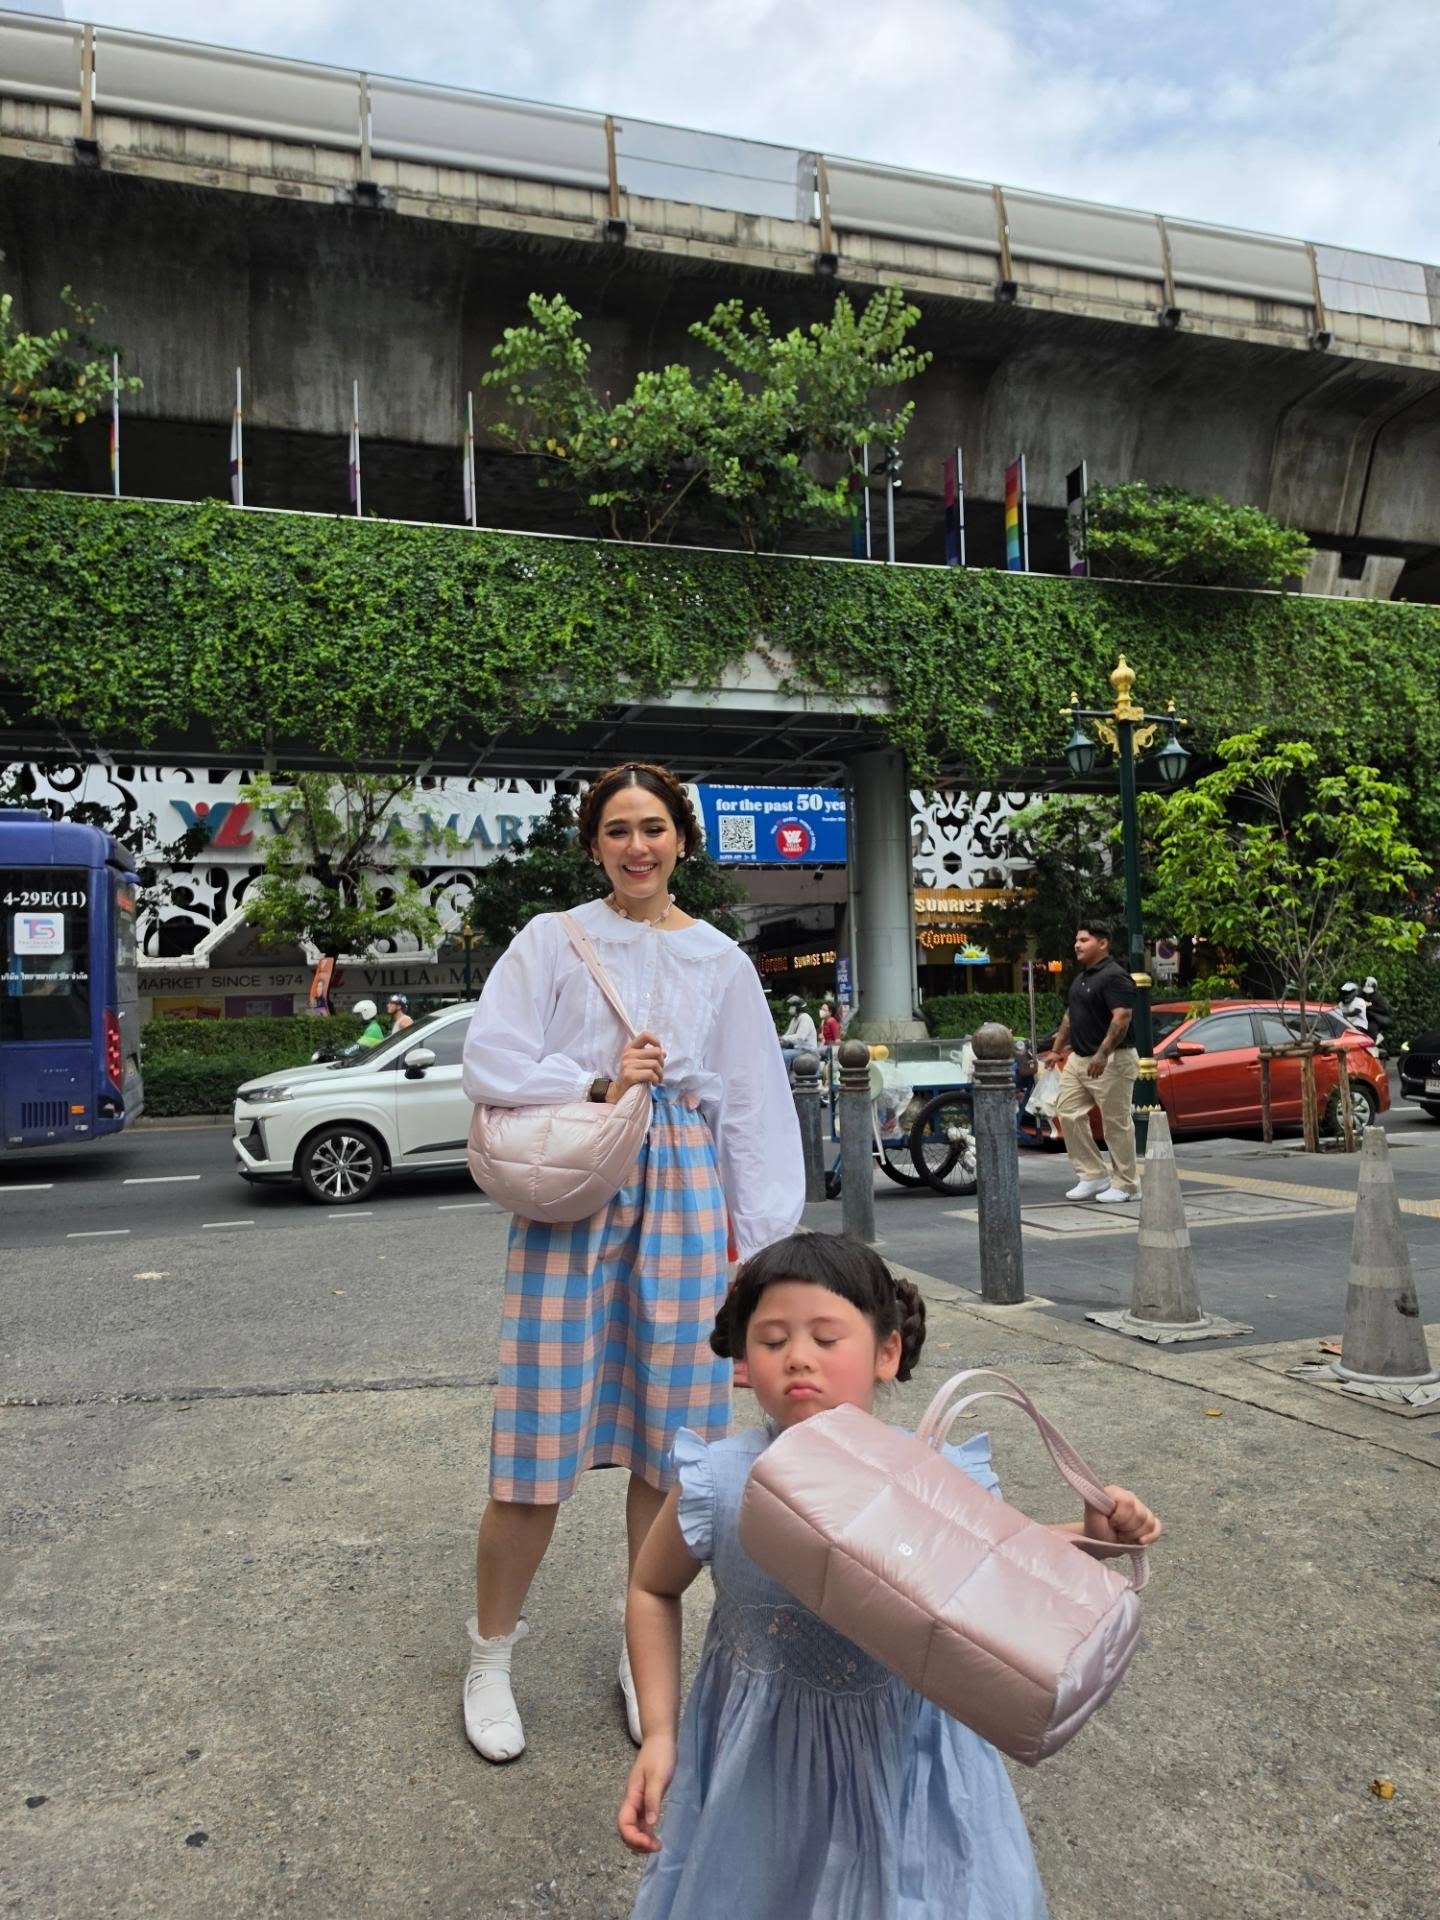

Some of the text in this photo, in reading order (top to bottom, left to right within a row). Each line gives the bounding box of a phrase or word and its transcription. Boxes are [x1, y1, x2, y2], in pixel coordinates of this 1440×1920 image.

[716, 798, 738, 811] for
[740, 798, 762, 811] the
[763, 800, 793, 814] past
[797, 794, 823, 811] 50
[3, 891, 87, 908] 4-29E(11)
[915, 898, 984, 912] SUNRISE
[917, 930, 968, 949] Corona
[794, 953, 820, 968] SUNRISE
[211, 975, 261, 988] SINCE
[268, 974, 303, 986] 1974
[363, 968, 431, 986] VILLA
